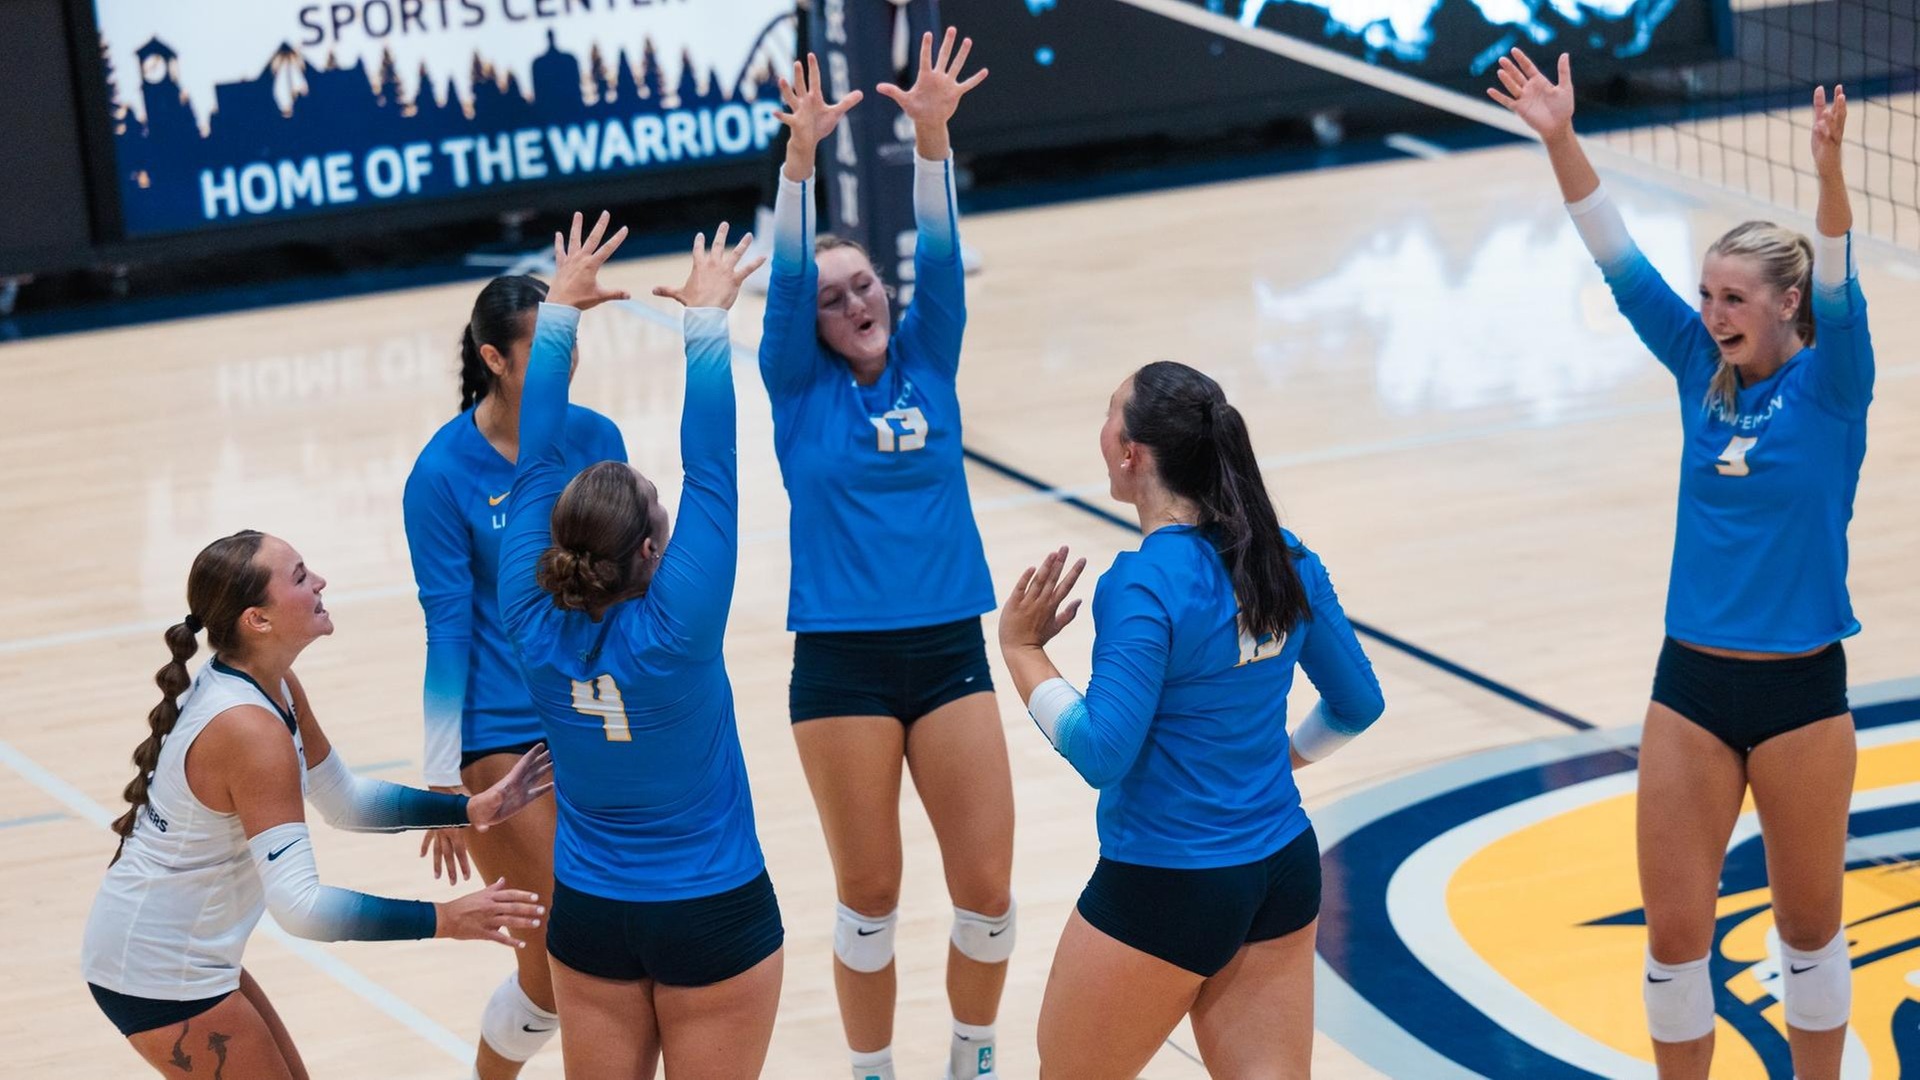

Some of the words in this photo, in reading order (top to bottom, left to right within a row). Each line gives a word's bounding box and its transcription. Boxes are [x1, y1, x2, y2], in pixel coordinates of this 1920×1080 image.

[200, 151, 358, 219] HOME
[364, 140, 433, 199] OF
[439, 127, 550, 188] THE
[869, 406, 929, 452] 13
[570, 673, 633, 742] 4
